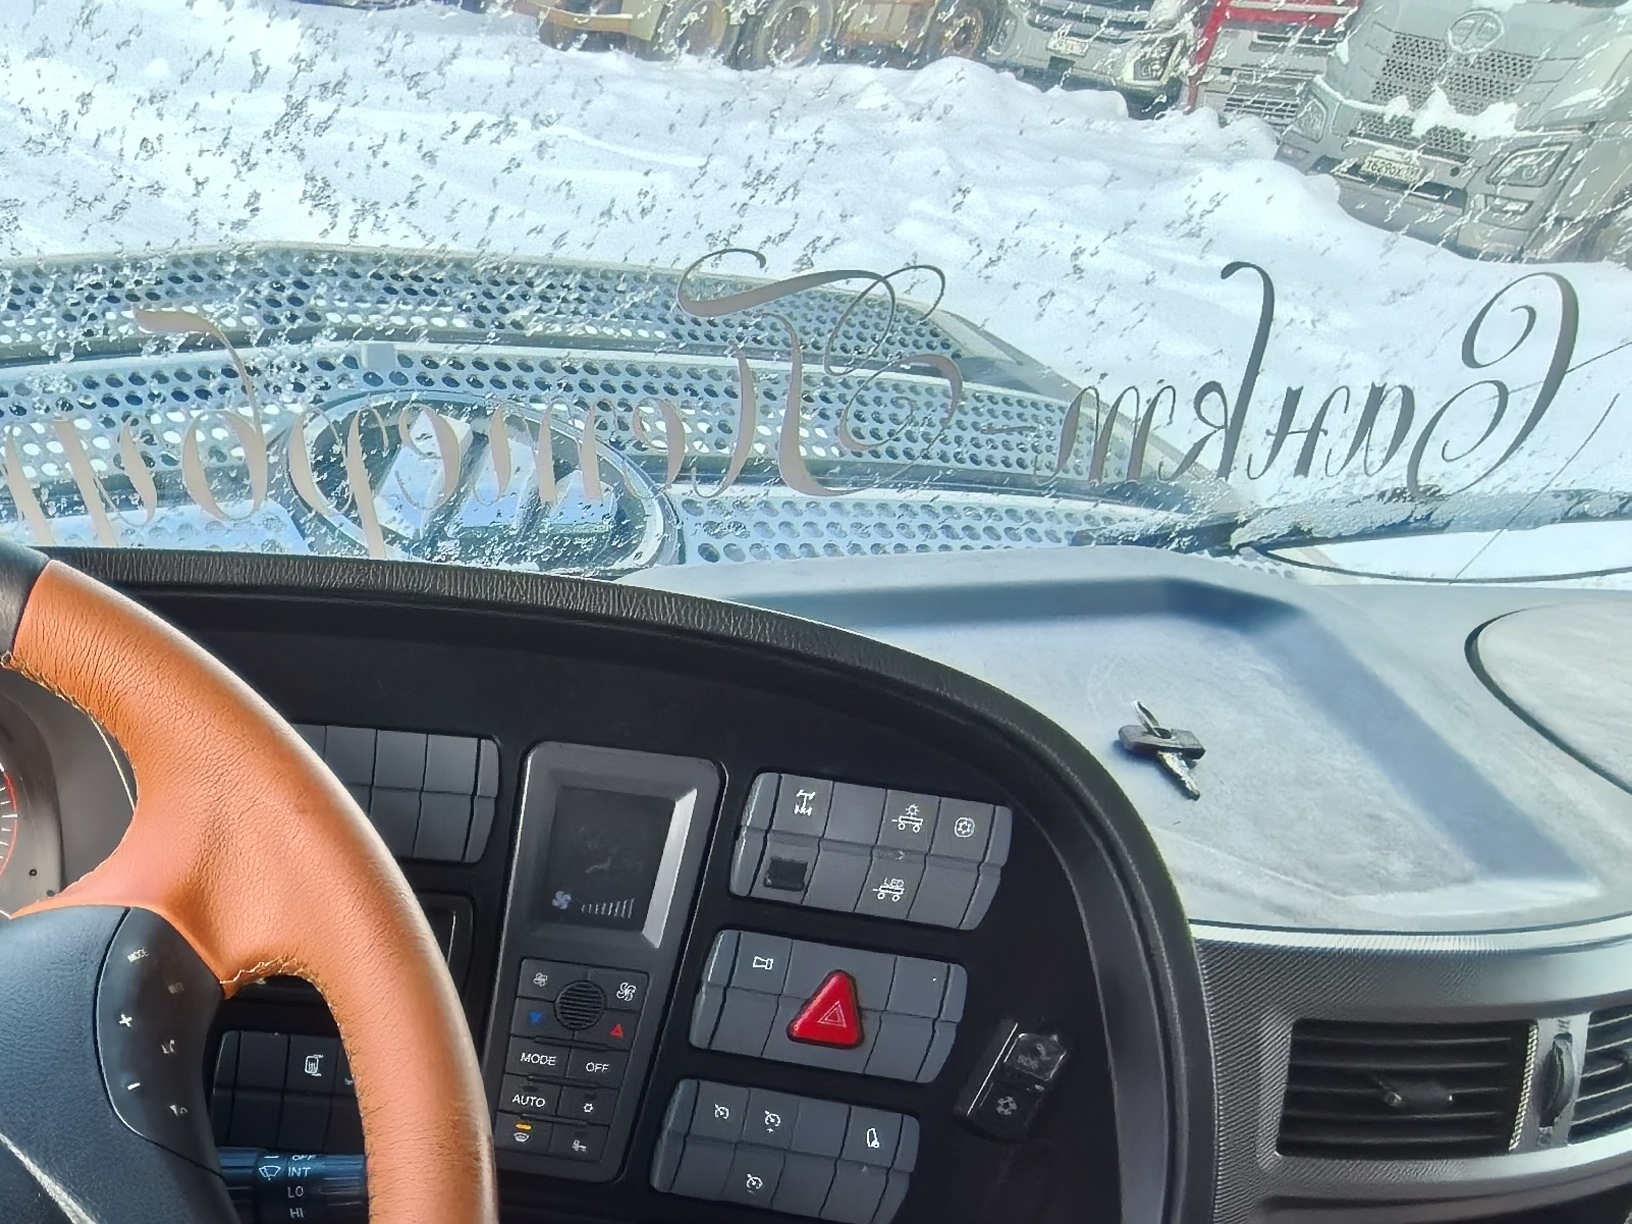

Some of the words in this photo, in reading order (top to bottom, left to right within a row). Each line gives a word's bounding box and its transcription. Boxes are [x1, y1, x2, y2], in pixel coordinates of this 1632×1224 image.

[520, 1052, 557, 1066] MODE
[585, 1062, 610, 1073] OFF
[512, 1094, 546, 1108] AUTO
[288, 1166, 311, 1178] INT
[287, 1185, 304, 1198] LO
[289, 1207, 304, 1219] HI
